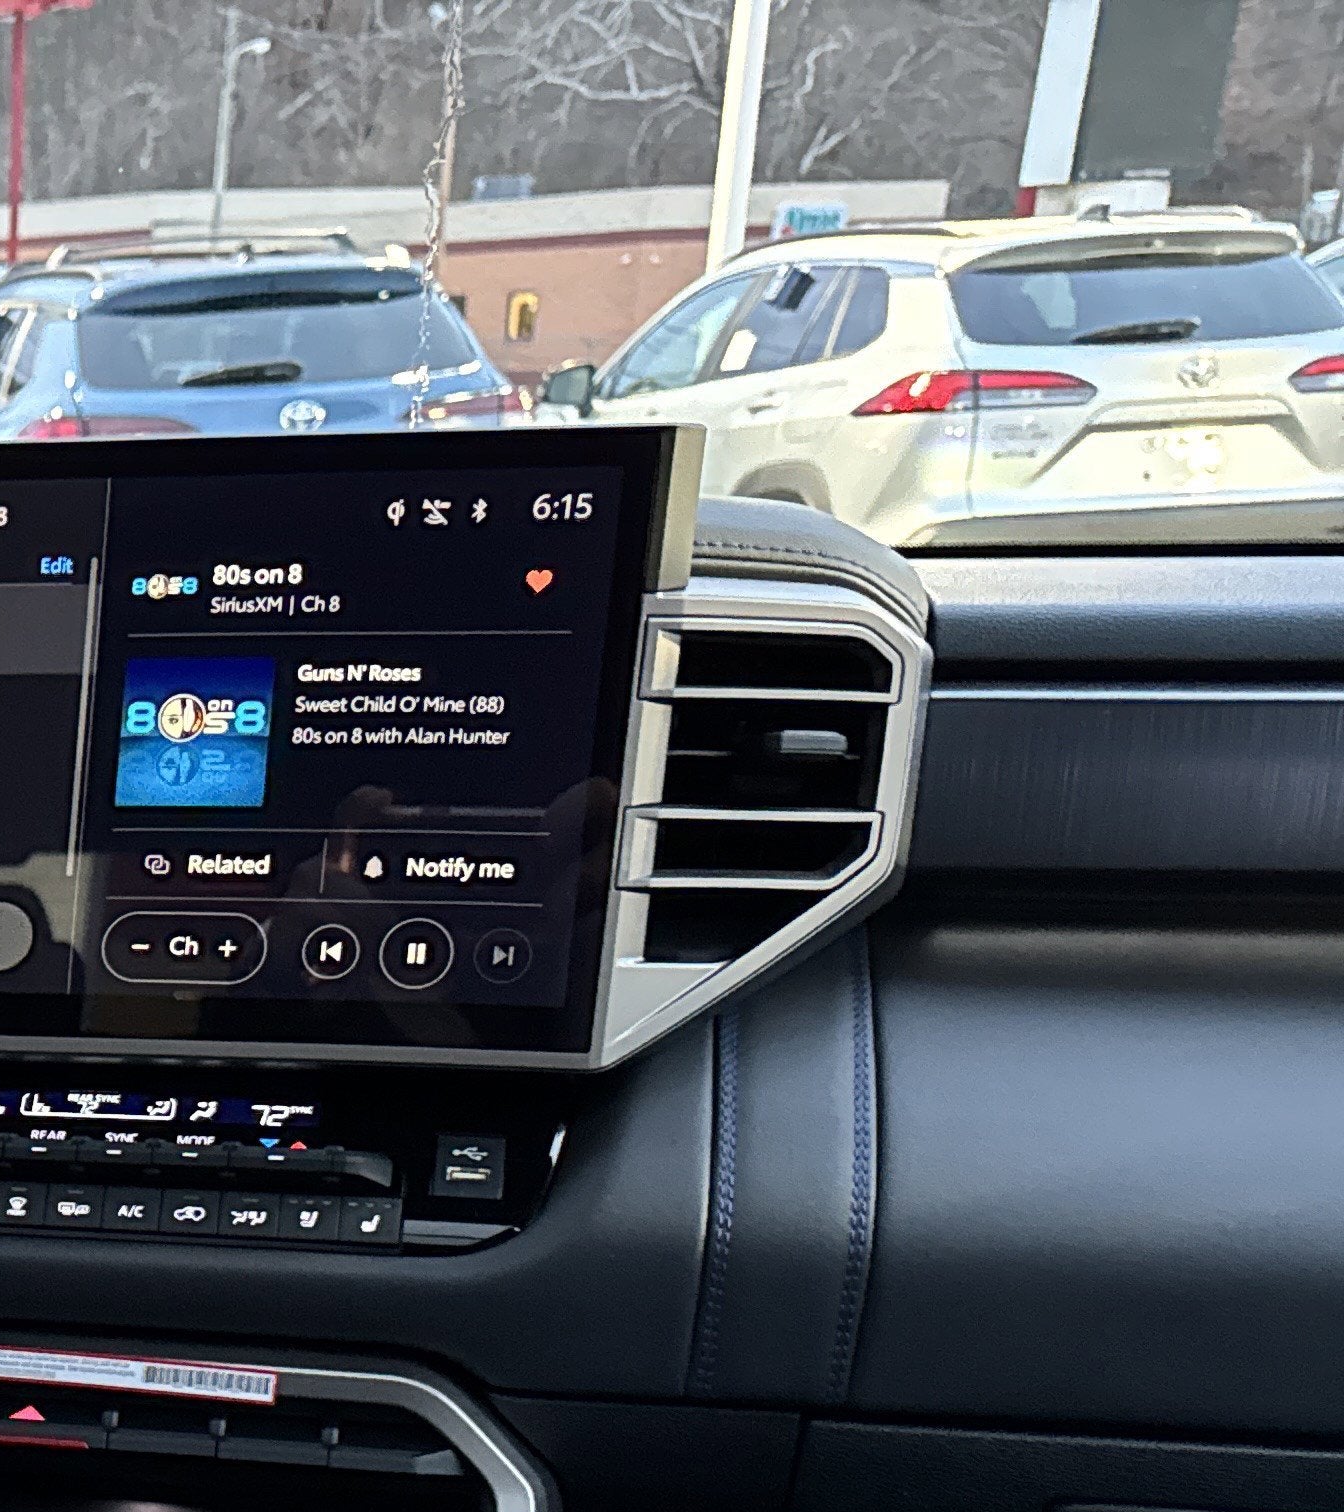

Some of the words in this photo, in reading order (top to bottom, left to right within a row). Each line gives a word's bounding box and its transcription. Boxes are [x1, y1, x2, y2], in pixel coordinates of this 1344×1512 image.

[532, 494, 593, 520] 6:15
[40, 557, 73, 575] Edit
[213, 566, 250, 585] 80s
[254, 569, 284, 584] on
[287, 565, 303, 583] 8
[211, 597, 283, 613] SiriusXM
[301, 597, 326, 613] Ch
[329, 596, 340, 612] 8
[297, 665, 344, 682] Guns
[347, 665, 367, 681] N'
[369, 665, 421, 681] Roses
[295, 696, 348, 714] Sweet
[351, 695, 397, 714] Child
[400, 696, 420, 714] O'
[422, 696, 465, 713] Mine
[469, 695, 505, 715] (88)
[292, 728, 321, 744] 80s
[324, 732, 348, 744] on
[351, 728, 362, 744] 8
[365, 728, 403, 744] with
[407, 728, 446, 744] Alan
[449, 728, 511, 745] Hunter
[187, 856, 271, 874] Related
[406, 858, 475, 882] Notify
[479, 863, 515, 878] me
[169, 937, 199, 956] Ch
[251, 1105, 289, 1127] 72
[105, 1132, 139, 1143] SYNC
[117, 1204, 144, 1218] A/C
